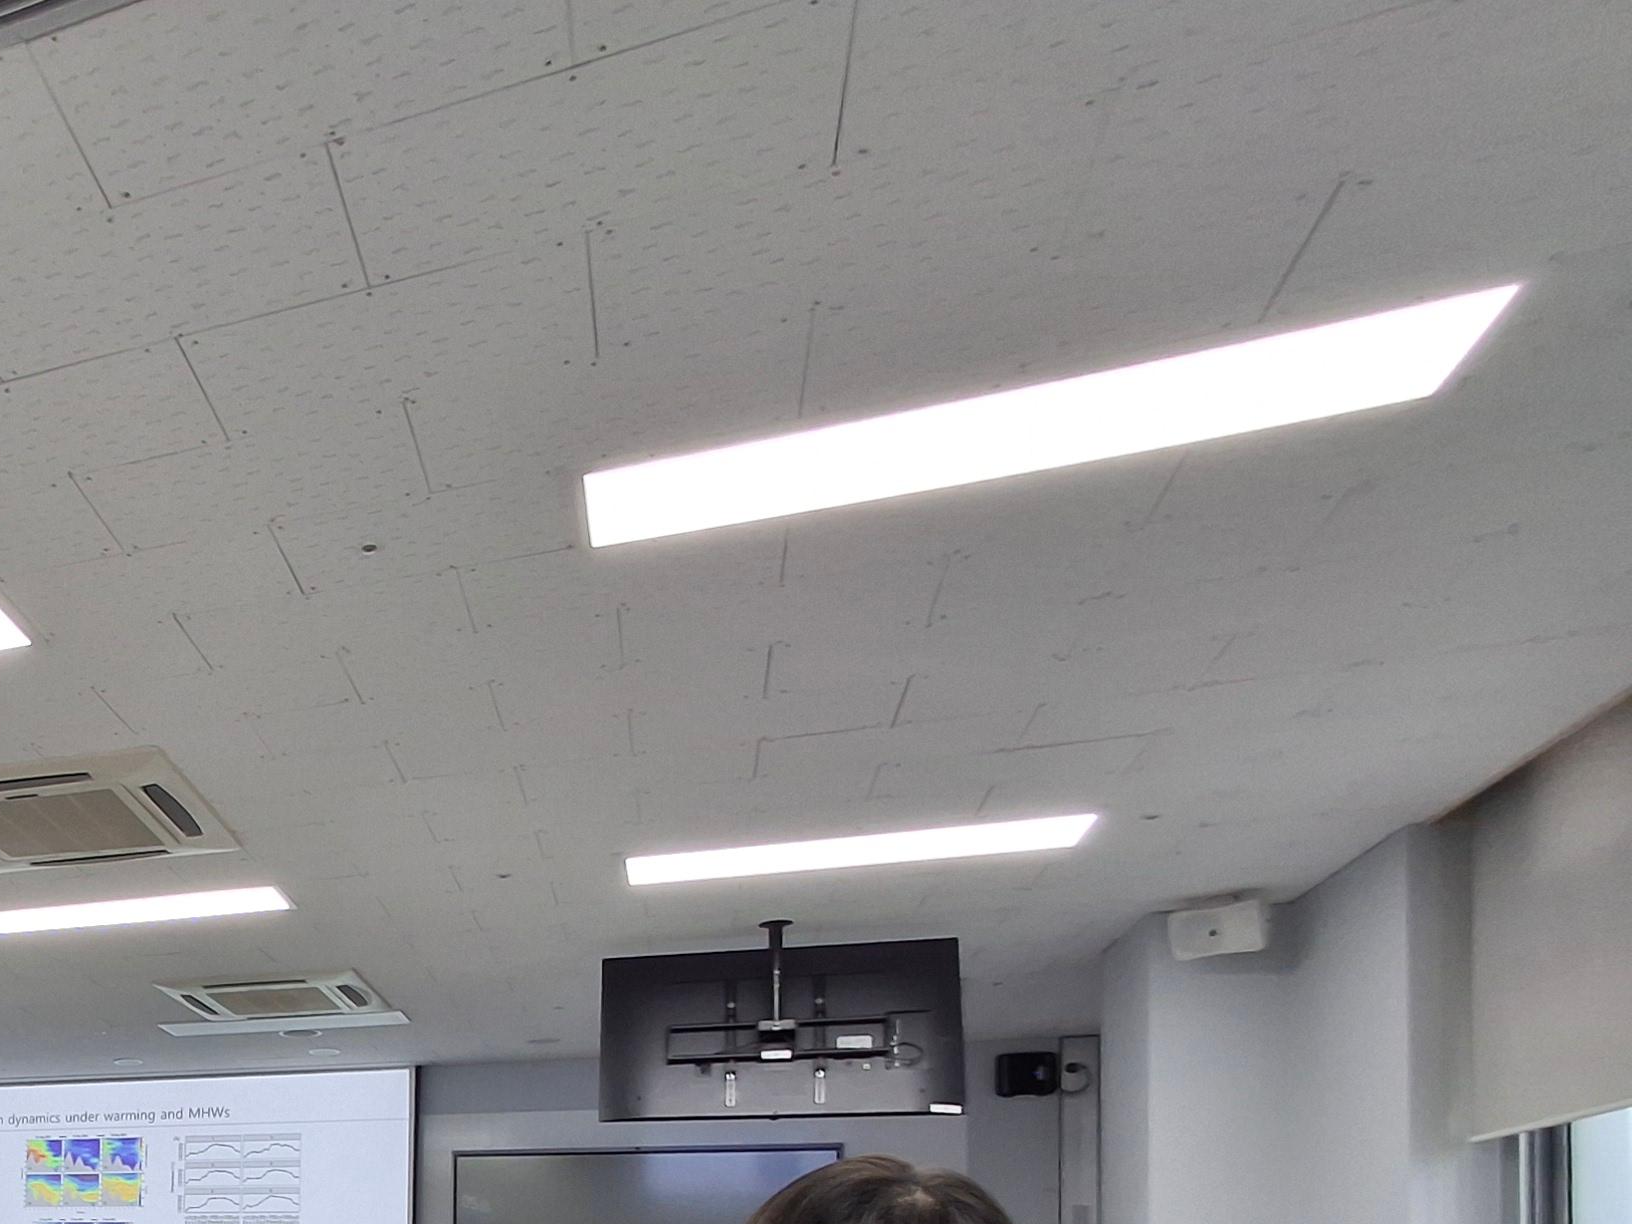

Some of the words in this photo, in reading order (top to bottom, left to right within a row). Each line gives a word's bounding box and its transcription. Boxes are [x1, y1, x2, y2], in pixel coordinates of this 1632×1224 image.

[8, 1112, 61, 1127] dynamics
[65, 1110, 99, 1123] under
[103, 1108, 156, 1124] warming
[160, 1107, 184, 1120] and
[189, 1106, 231, 1119] MHWs
